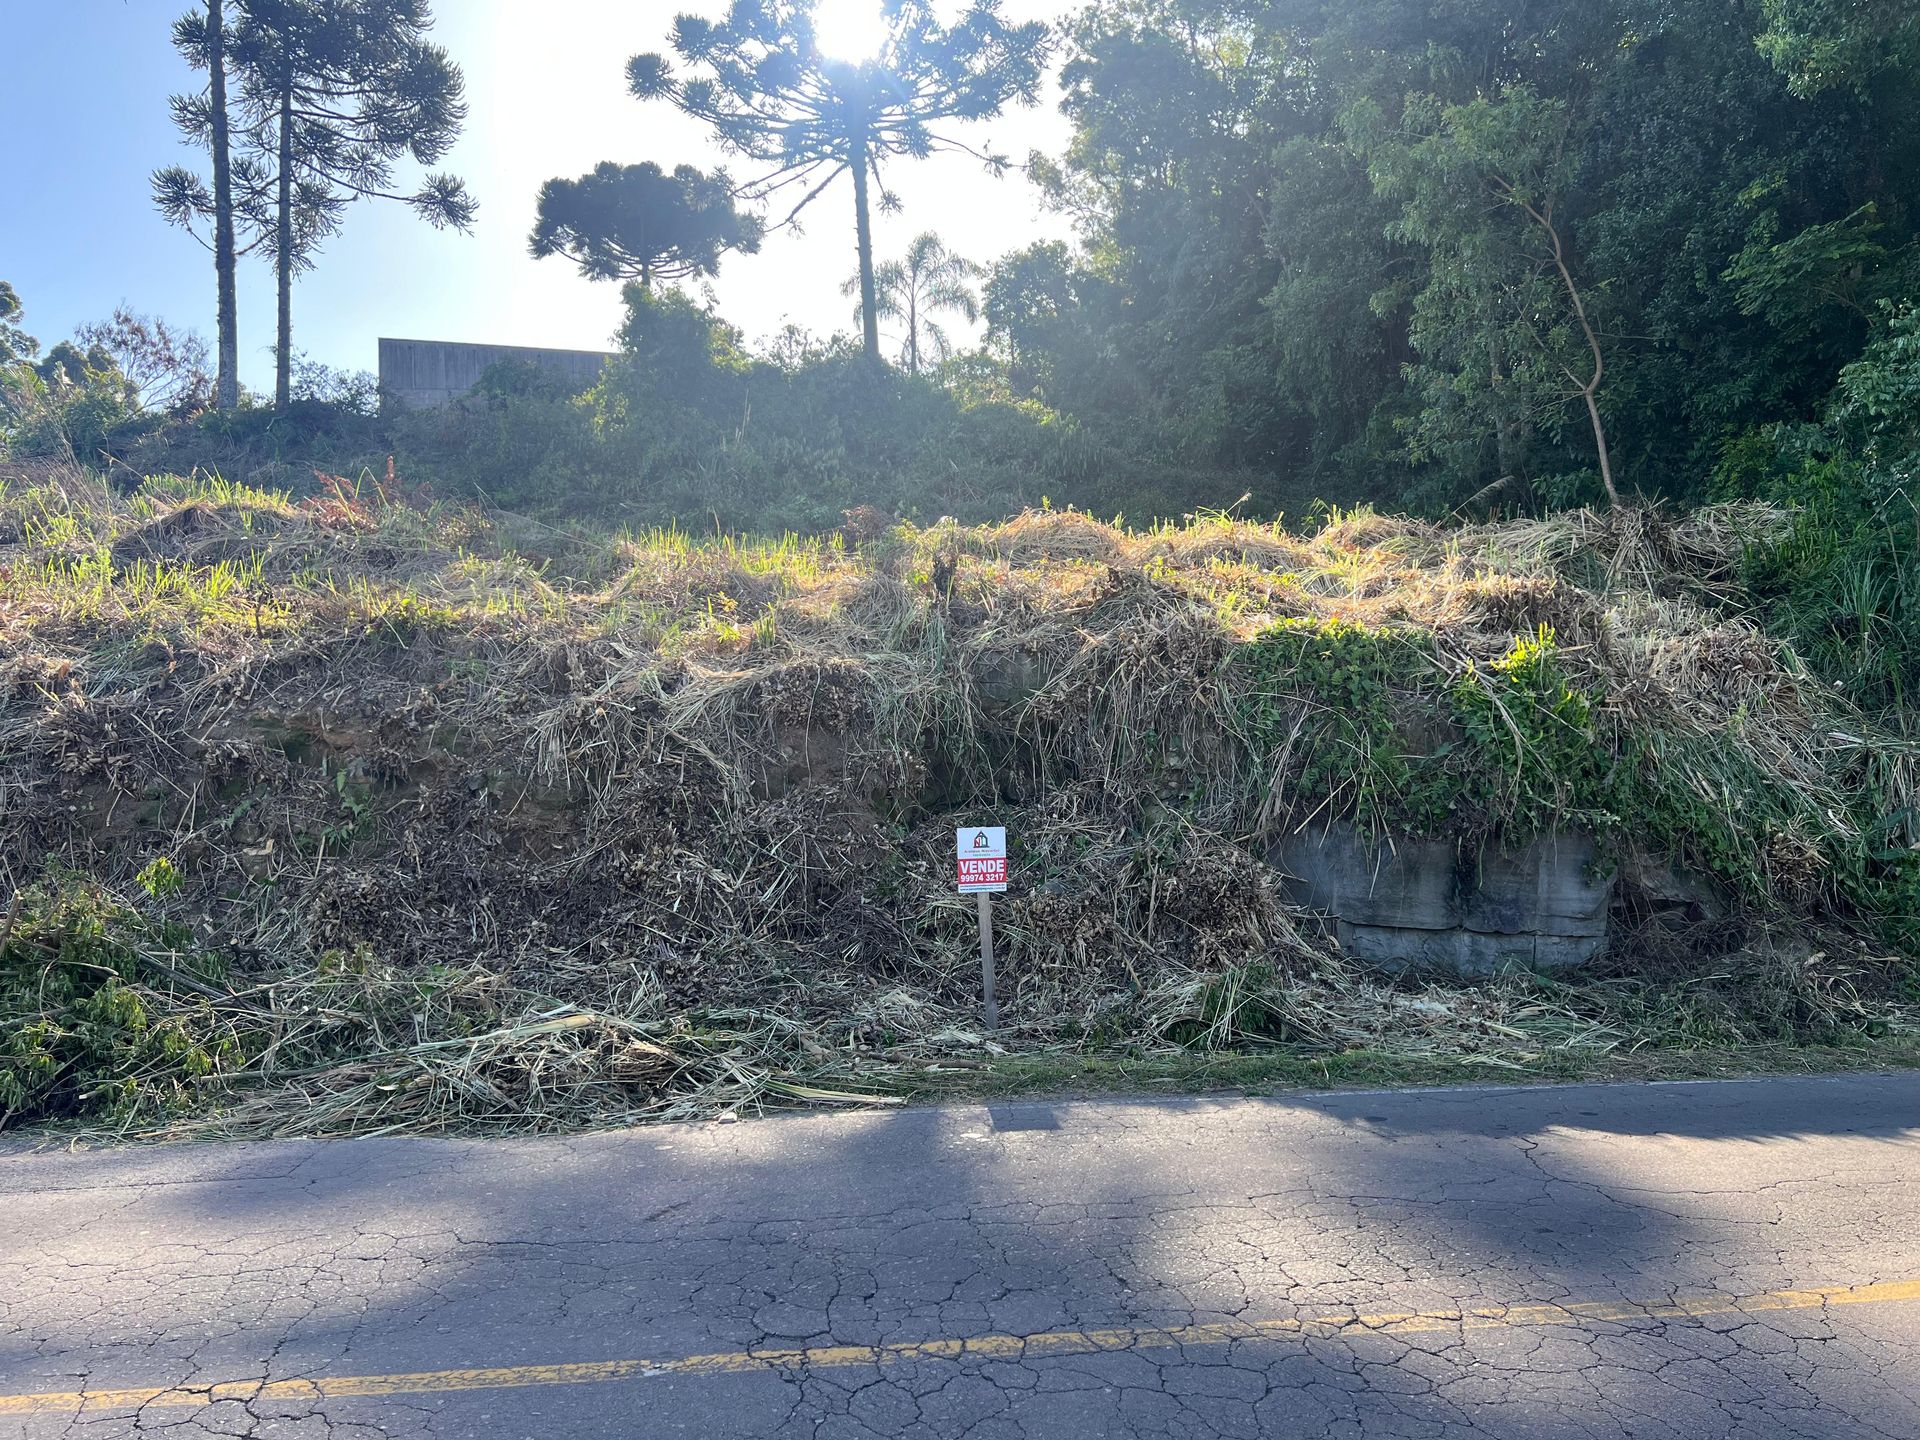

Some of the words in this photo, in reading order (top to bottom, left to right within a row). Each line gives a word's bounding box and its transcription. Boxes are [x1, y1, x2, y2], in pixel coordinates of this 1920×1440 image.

[960, 860, 1004, 873] VENDE
[961, 874, 984, 882] 99974
[985, 873, 1004, 881] 3217
